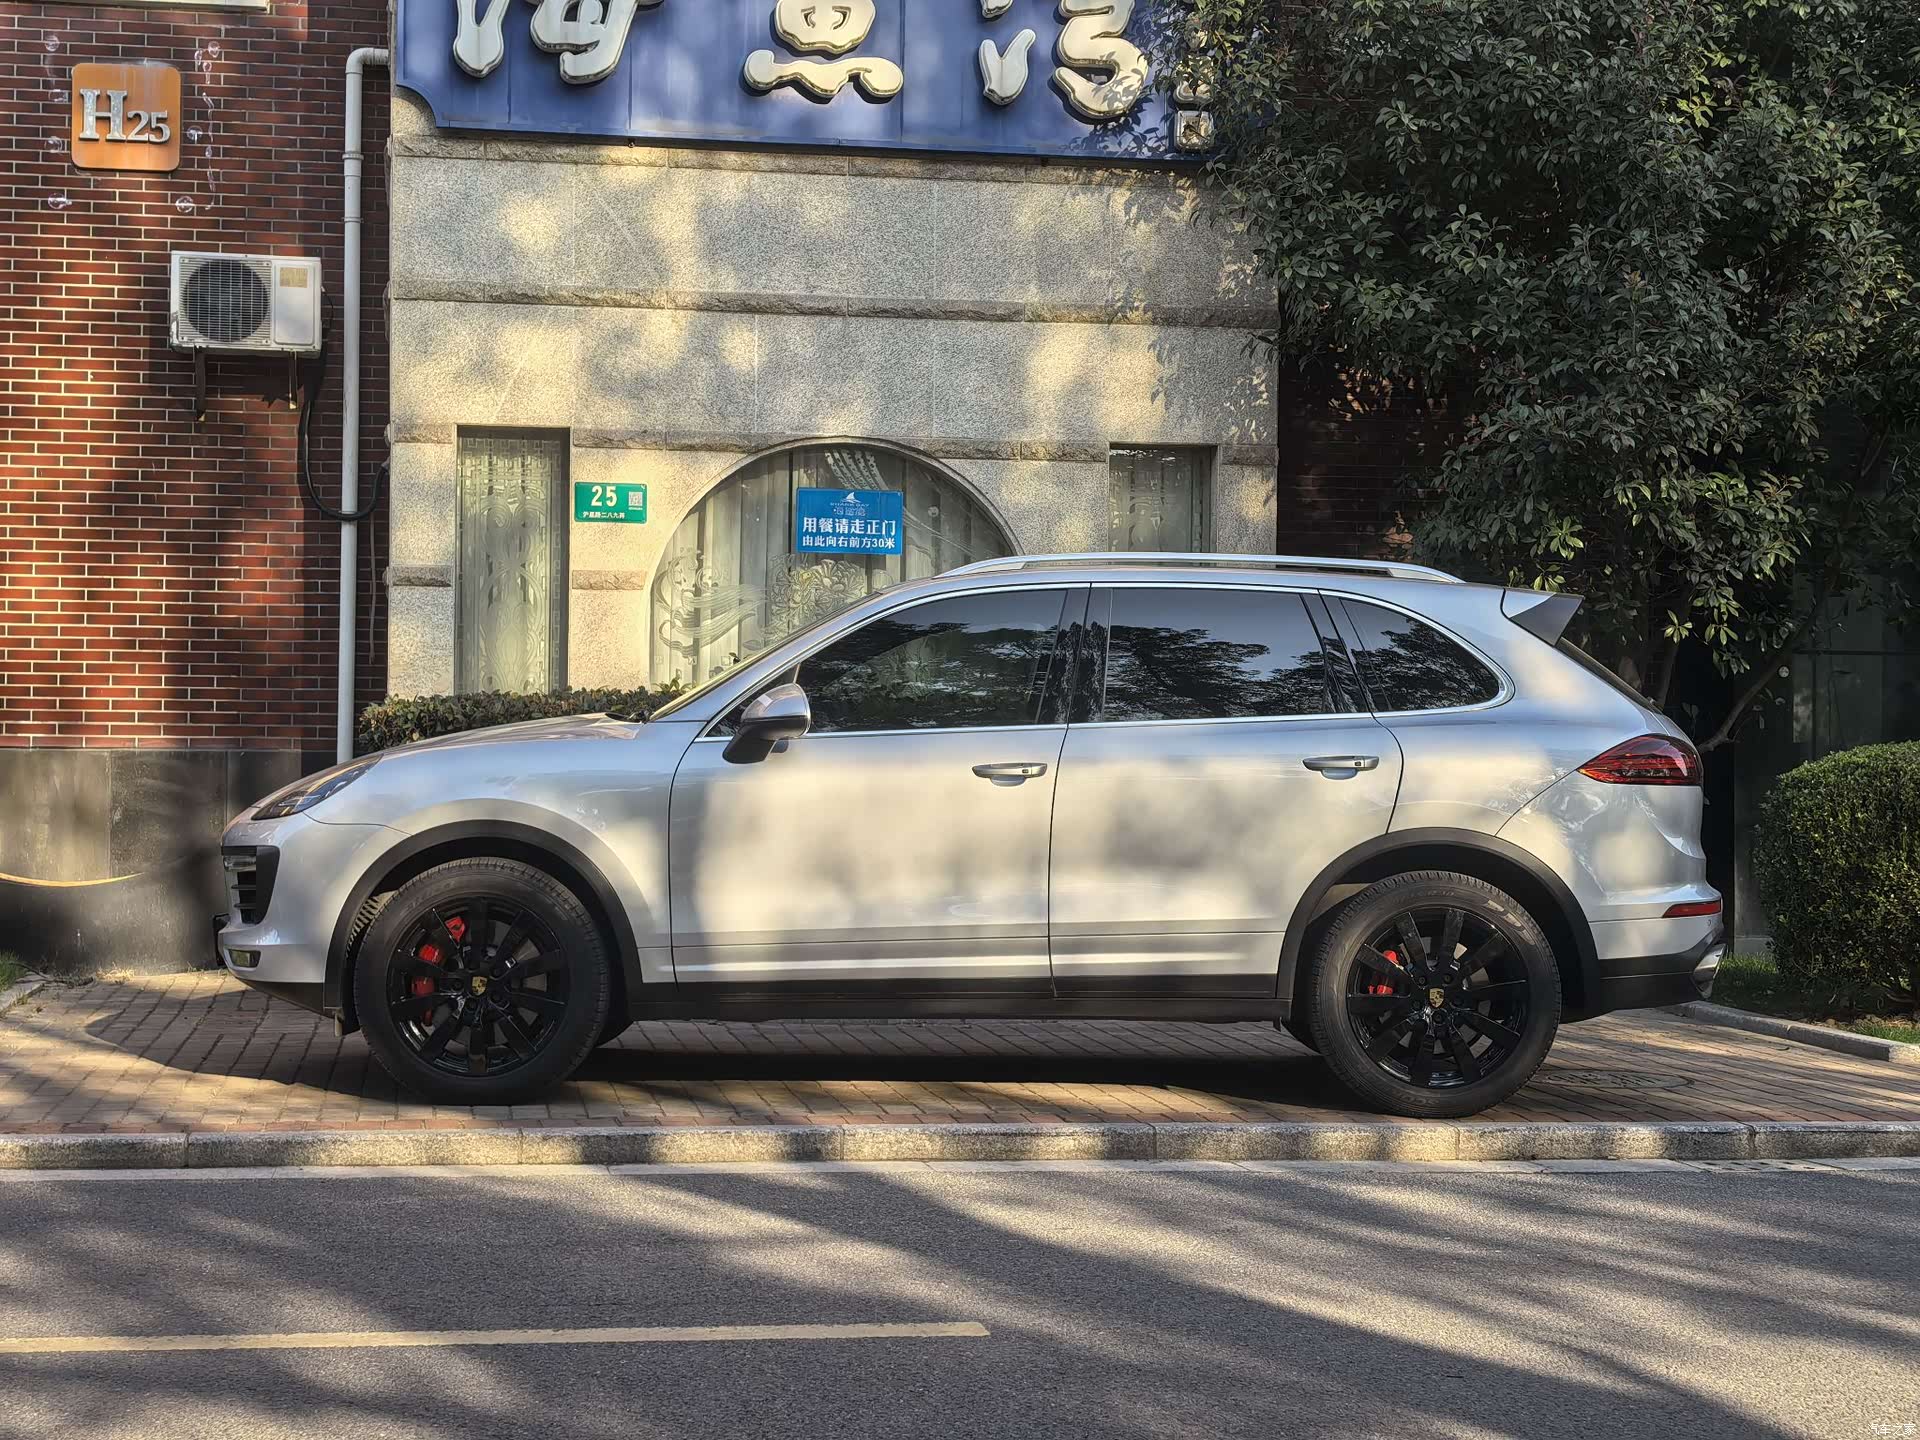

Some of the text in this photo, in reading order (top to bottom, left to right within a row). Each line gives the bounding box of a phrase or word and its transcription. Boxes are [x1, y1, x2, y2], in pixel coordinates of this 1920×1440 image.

[79, 88, 171, 144] H25
[591, 485, 618, 507] 25
[802, 517, 896, 536] 用餐请走正门
[802, 535, 896, 549] 由此向右前方30米
